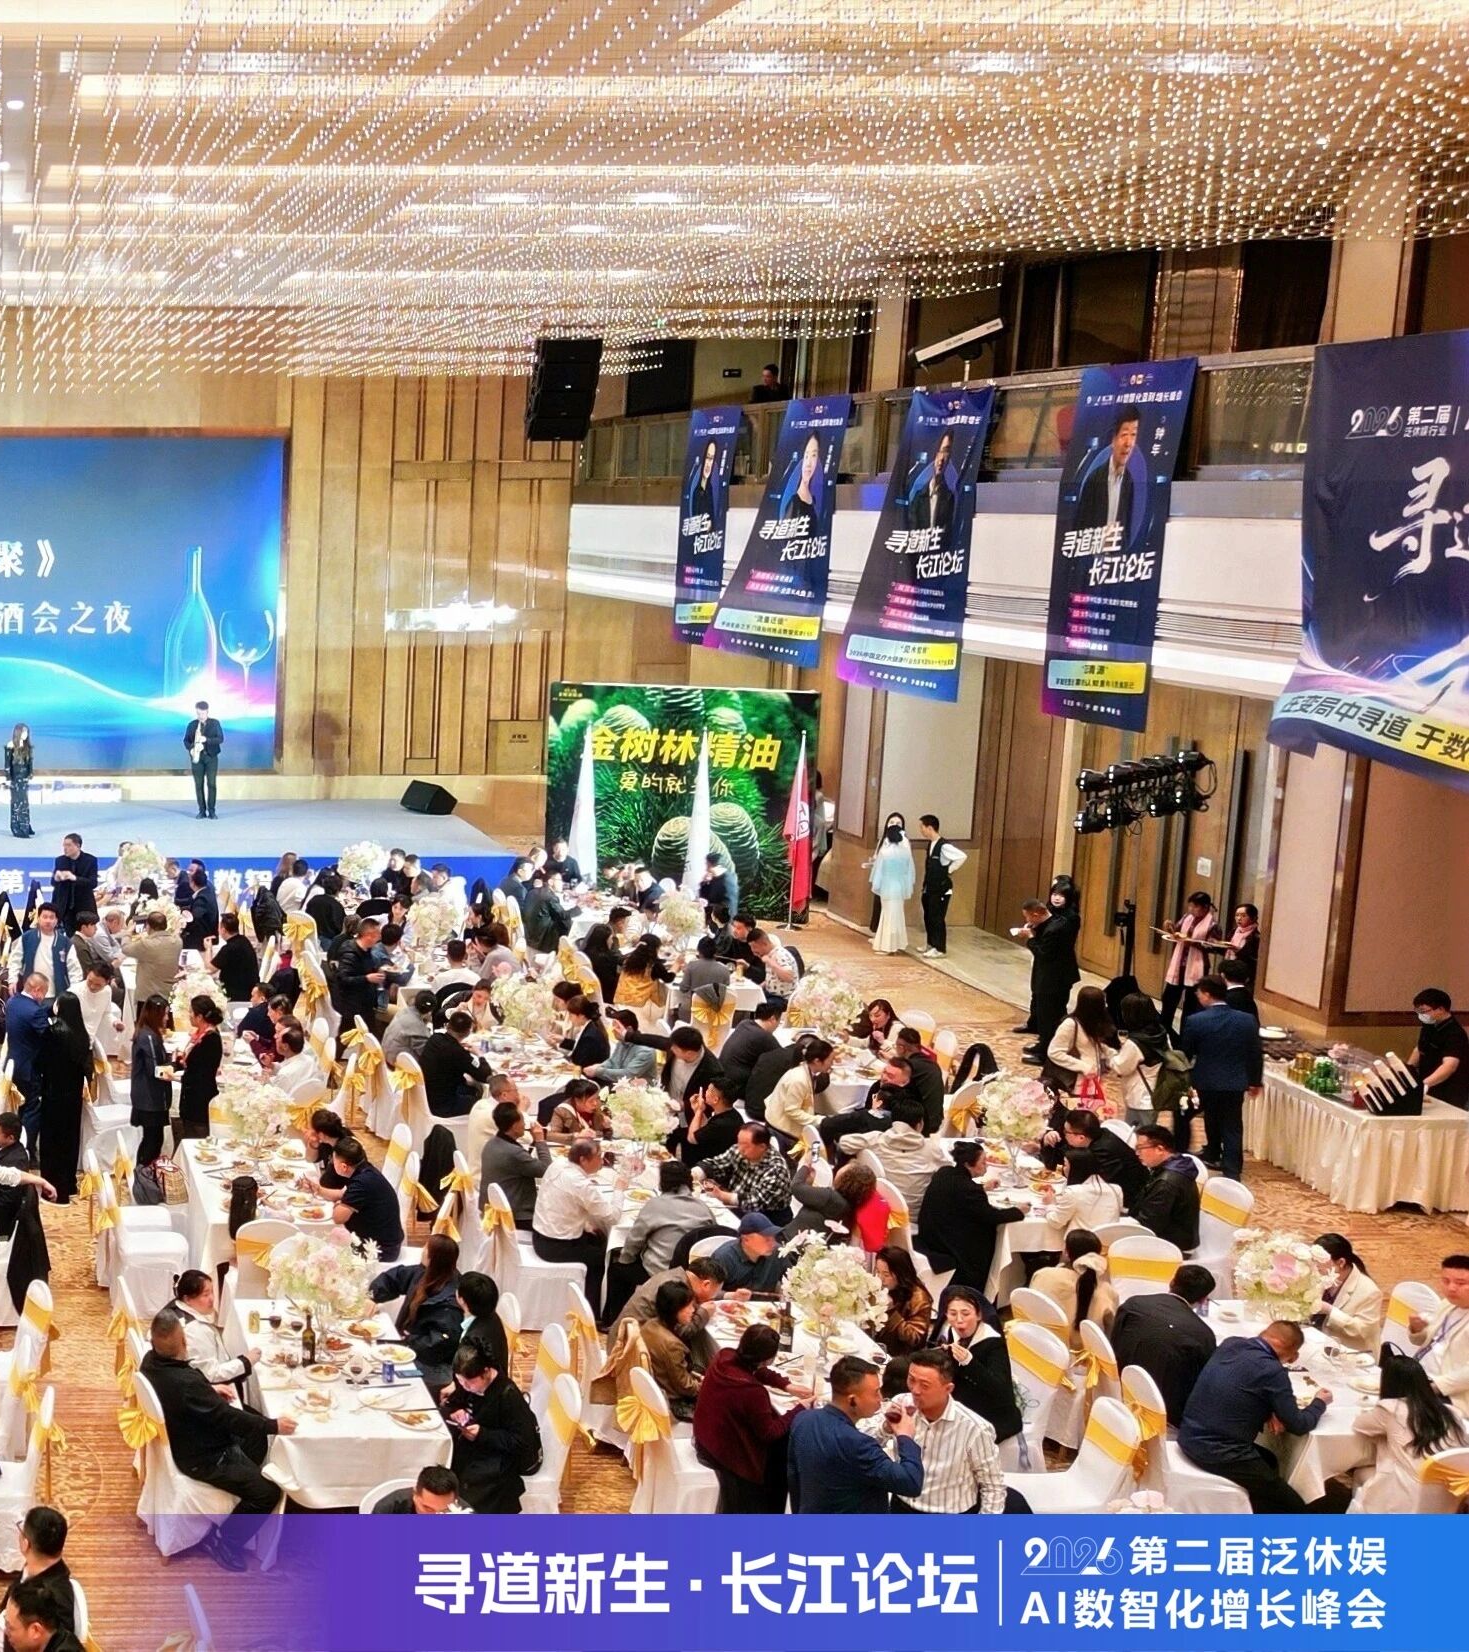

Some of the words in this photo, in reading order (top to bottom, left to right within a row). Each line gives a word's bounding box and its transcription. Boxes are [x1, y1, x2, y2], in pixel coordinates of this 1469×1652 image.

[1407, 404, 1452, 426] 第二届
[883, 525, 945, 554] 寻道新生
[1061, 521, 1124, 558] 寻道新生
[915, 549, 965, 579] 长江论坛
[1088, 551, 1156, 586] 长江论坛
[1281, 695, 1412, 742] 在变局中寻道
[582, 725, 782, 771] 金树林精油
[619, 770, 734, 797] 爱的就你
